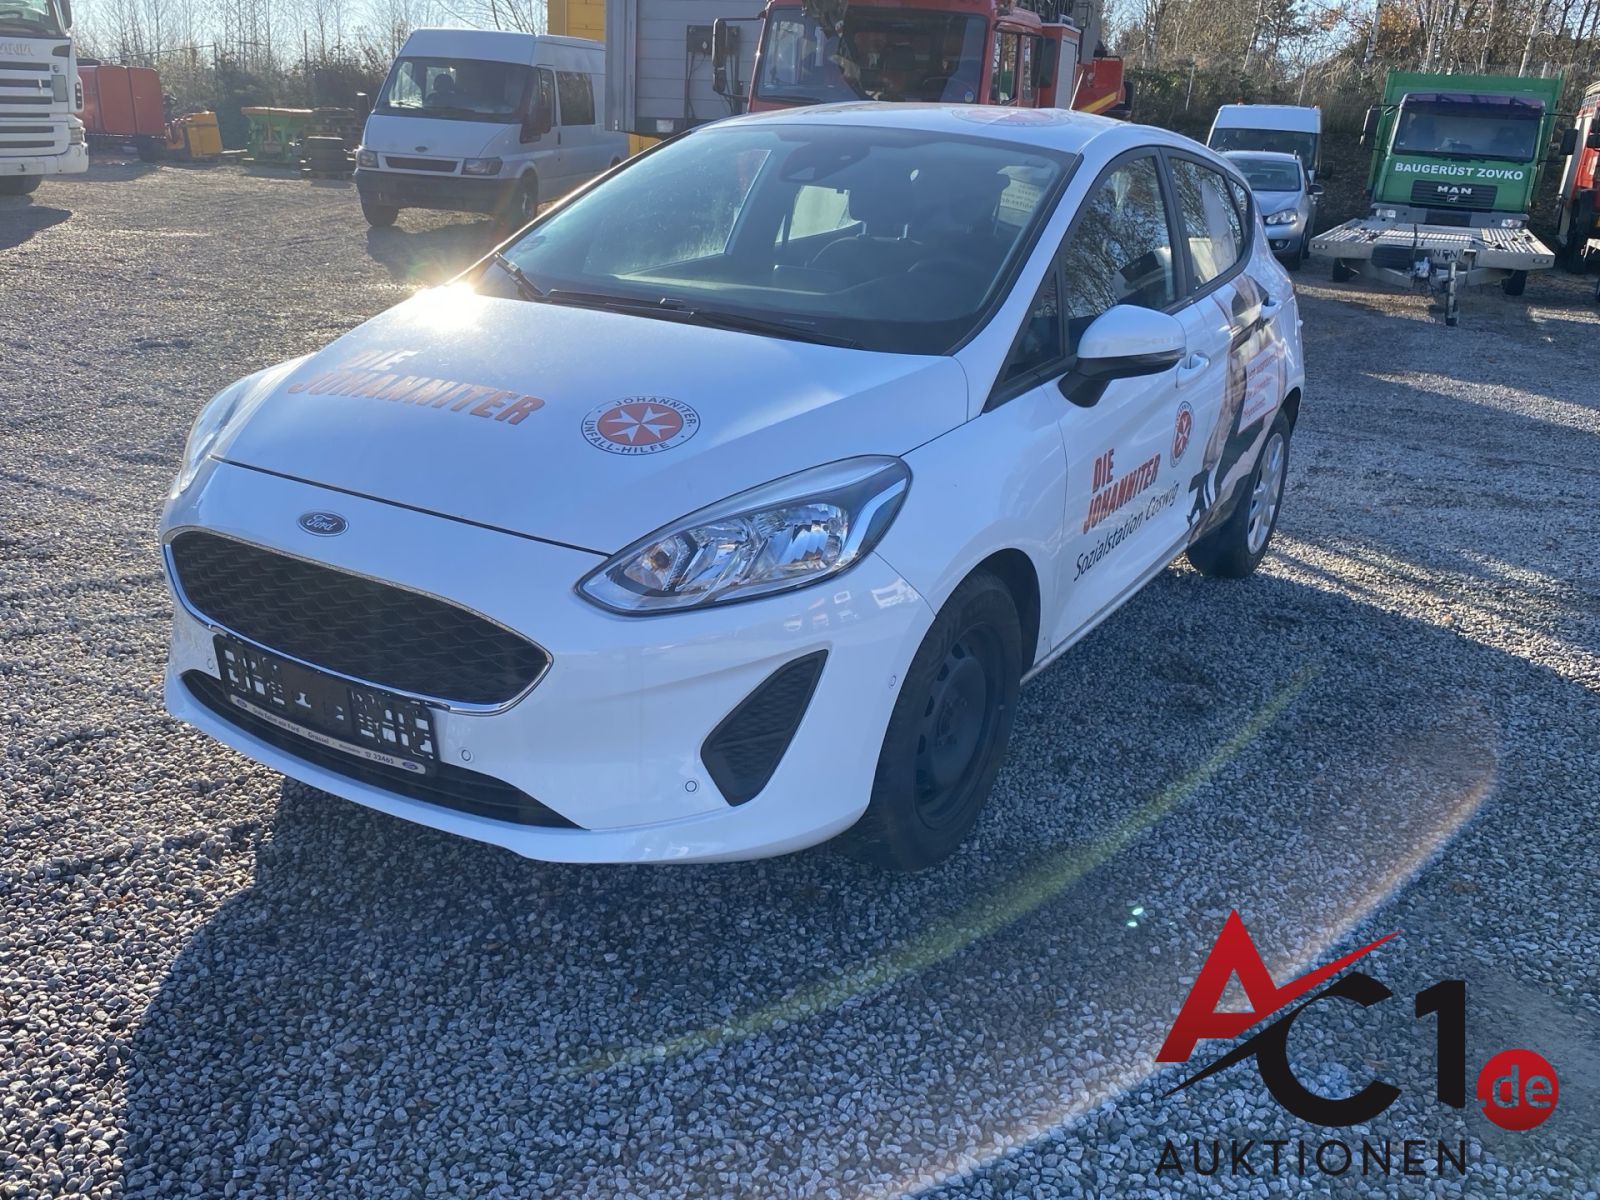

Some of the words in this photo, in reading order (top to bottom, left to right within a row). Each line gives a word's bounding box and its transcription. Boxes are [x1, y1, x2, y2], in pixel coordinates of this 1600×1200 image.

[1395, 162, 1473, 176] BAUGERÜST
[1476, 167, 1525, 181] ZOVKO
[1437, 185, 1473, 195] MAN
[287, 371, 547, 426] JOHANNITER
[584, 420, 671, 454] UNFALL-HILFE
[1083, 453, 1161, 535] JOHANNITER
[1092, 447, 1115, 494] DIE
[1073, 511, 1144, 582] Sozialstation
[1145, 479, 1180, 521] Coswig
